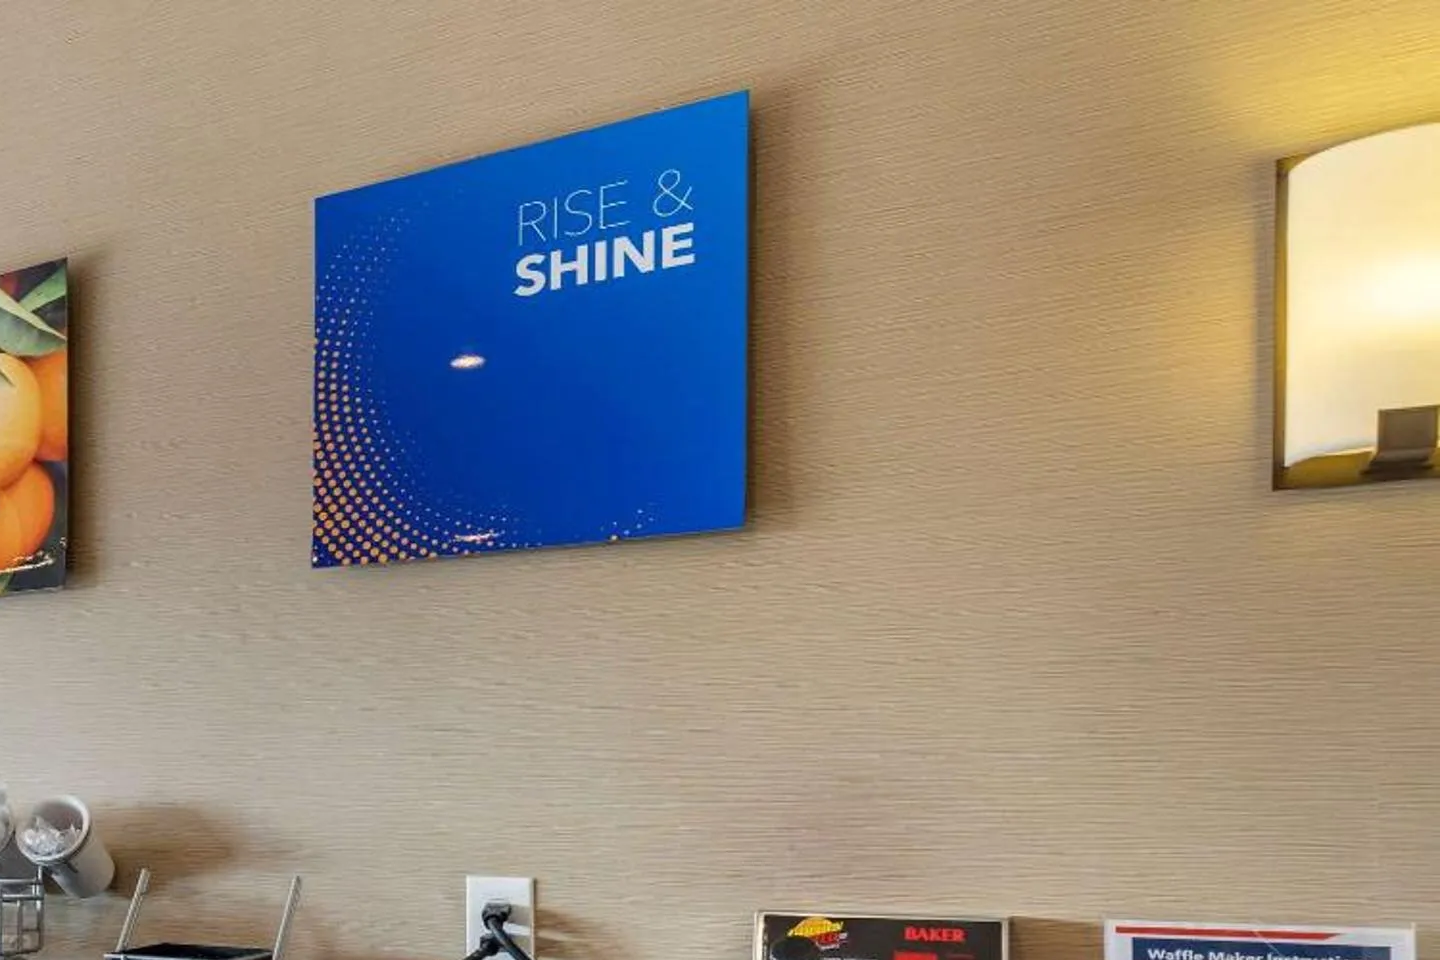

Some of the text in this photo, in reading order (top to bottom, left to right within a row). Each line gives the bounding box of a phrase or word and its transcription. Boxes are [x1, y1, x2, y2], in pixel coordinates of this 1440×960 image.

[518, 168, 694, 246] RISE &
[513, 221, 696, 297] SHINE
[903, 925, 967, 943] BAKER
